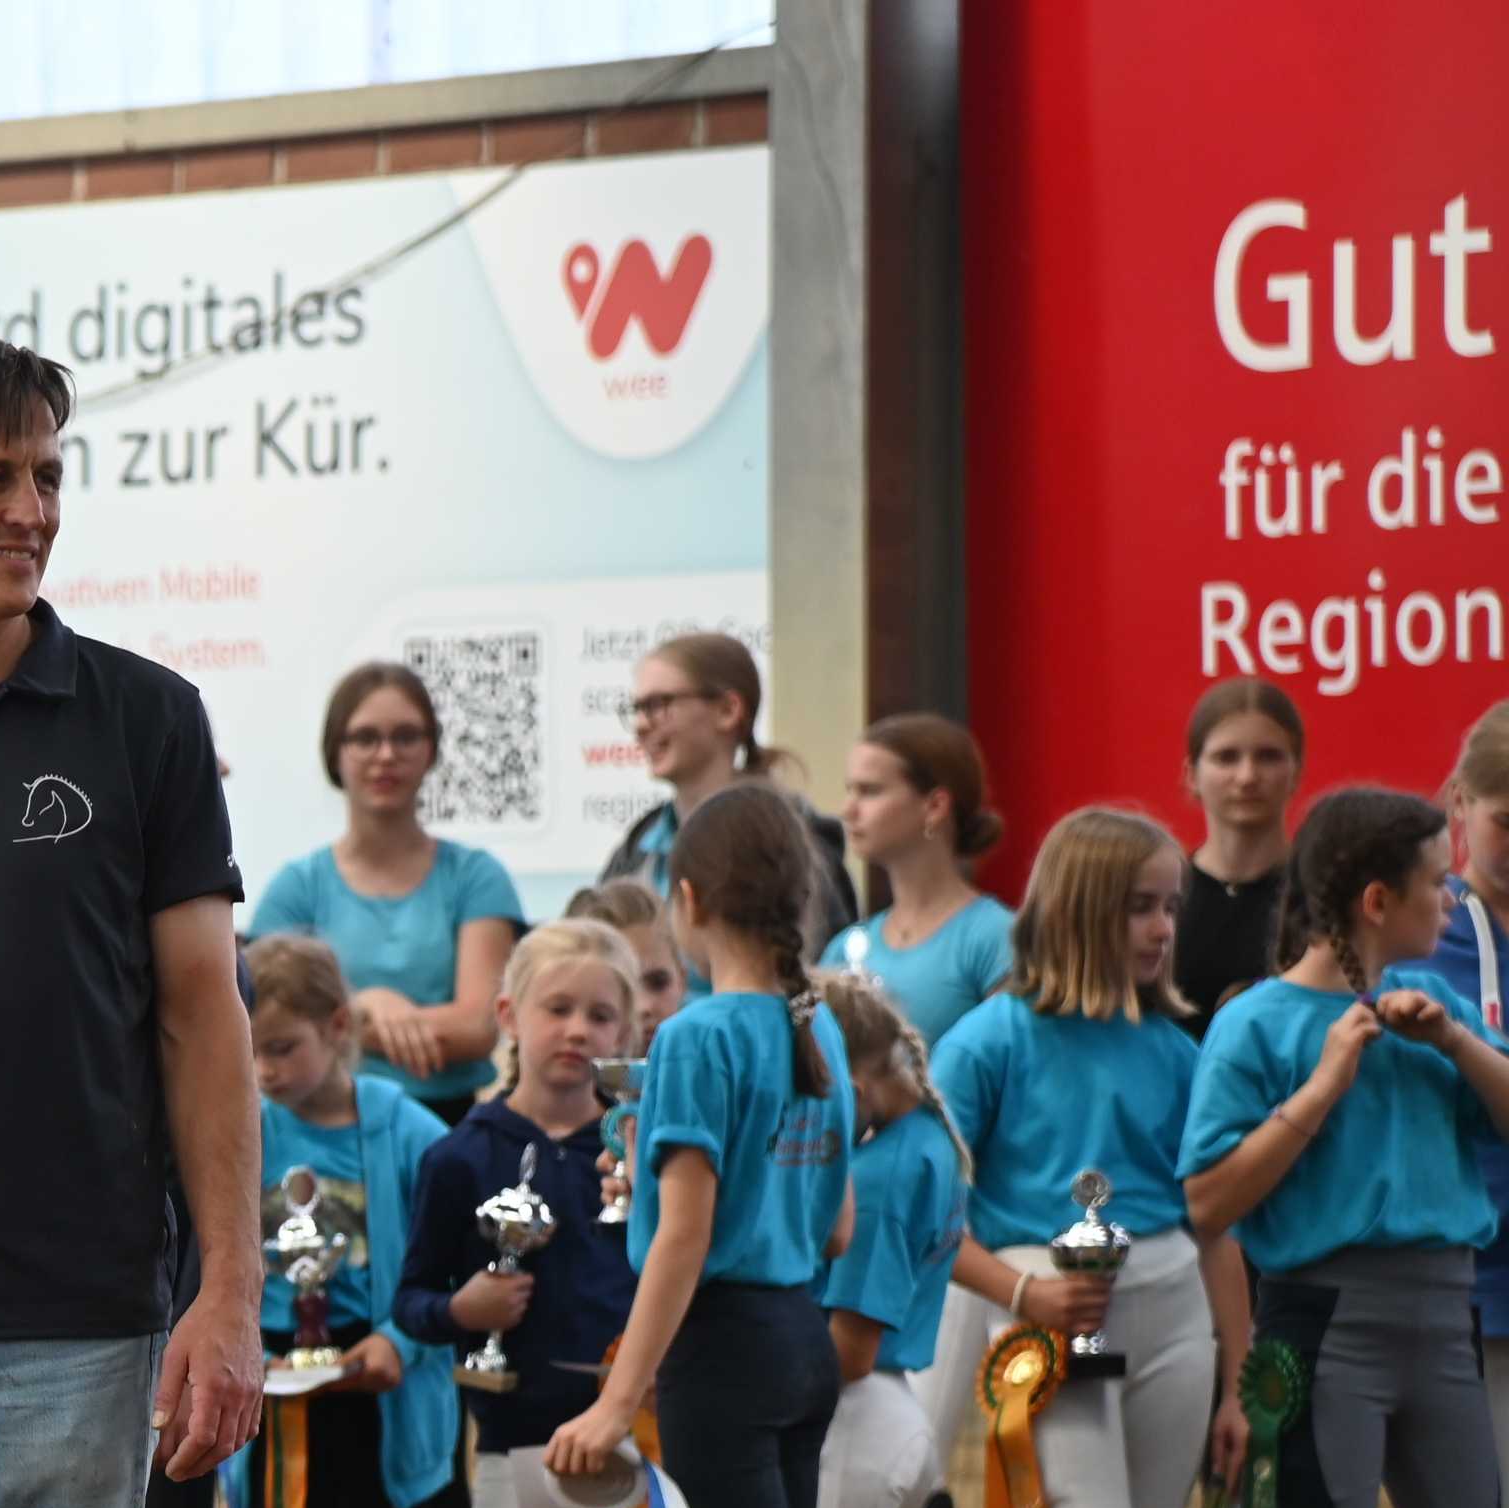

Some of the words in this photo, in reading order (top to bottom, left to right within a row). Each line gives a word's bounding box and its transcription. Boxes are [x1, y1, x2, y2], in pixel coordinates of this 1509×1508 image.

[69, 271, 366, 380] digitales
[1212, 192, 1496, 372] Gut
[119, 425, 226, 488] zur
[255, 394, 390, 479] Kür.
[603, 374, 671, 400] wee
[1218, 436, 1345, 541] für
[1366, 425, 1502, 529] die
[159, 560, 262, 601] Mobile
[1200, 567, 1504, 696] Region
